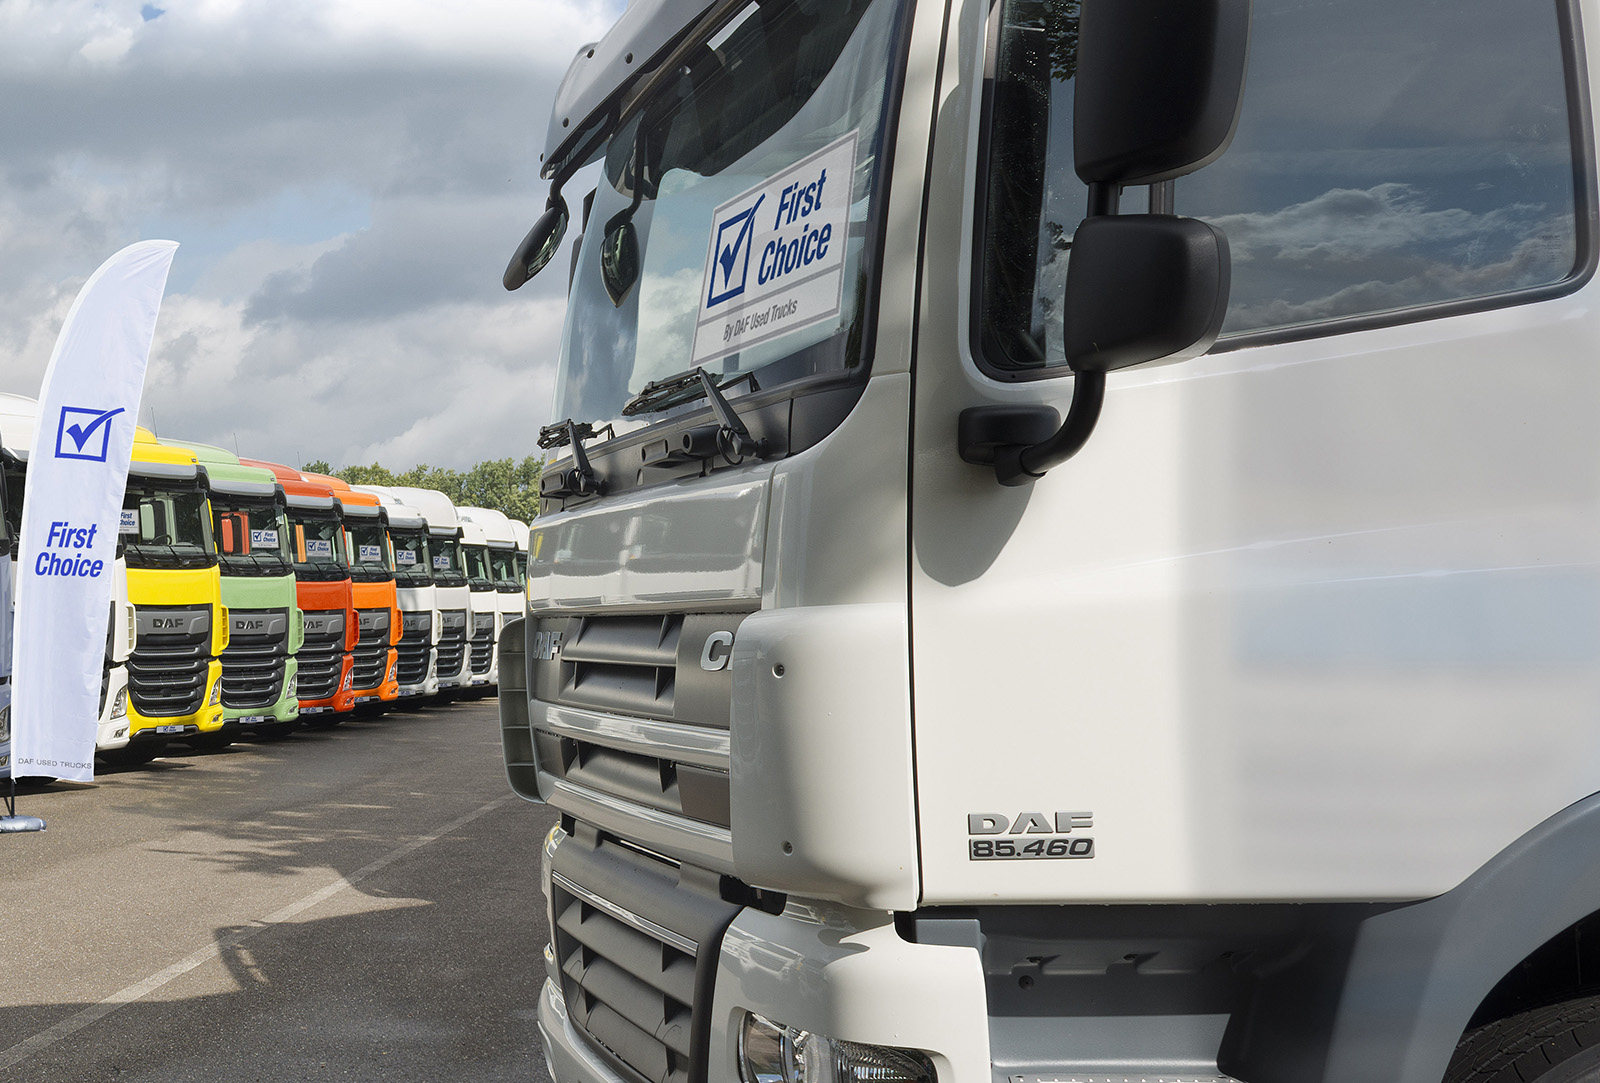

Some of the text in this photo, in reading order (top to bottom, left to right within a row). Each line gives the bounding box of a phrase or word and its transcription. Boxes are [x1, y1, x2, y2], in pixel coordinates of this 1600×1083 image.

[774, 168, 826, 231] First
[758, 223, 832, 286] Choice
[722, 298, 798, 342] By DAF Used Trucks
[46, 522, 97, 548] First
[35, 552, 104, 577] Choice
[152, 618, 184, 628] DAF
[235, 620, 263, 630] DAF
[700, 630, 734, 672] C
[968, 812, 1093, 835] DAF
[973, 839, 1093, 857] 85.460
